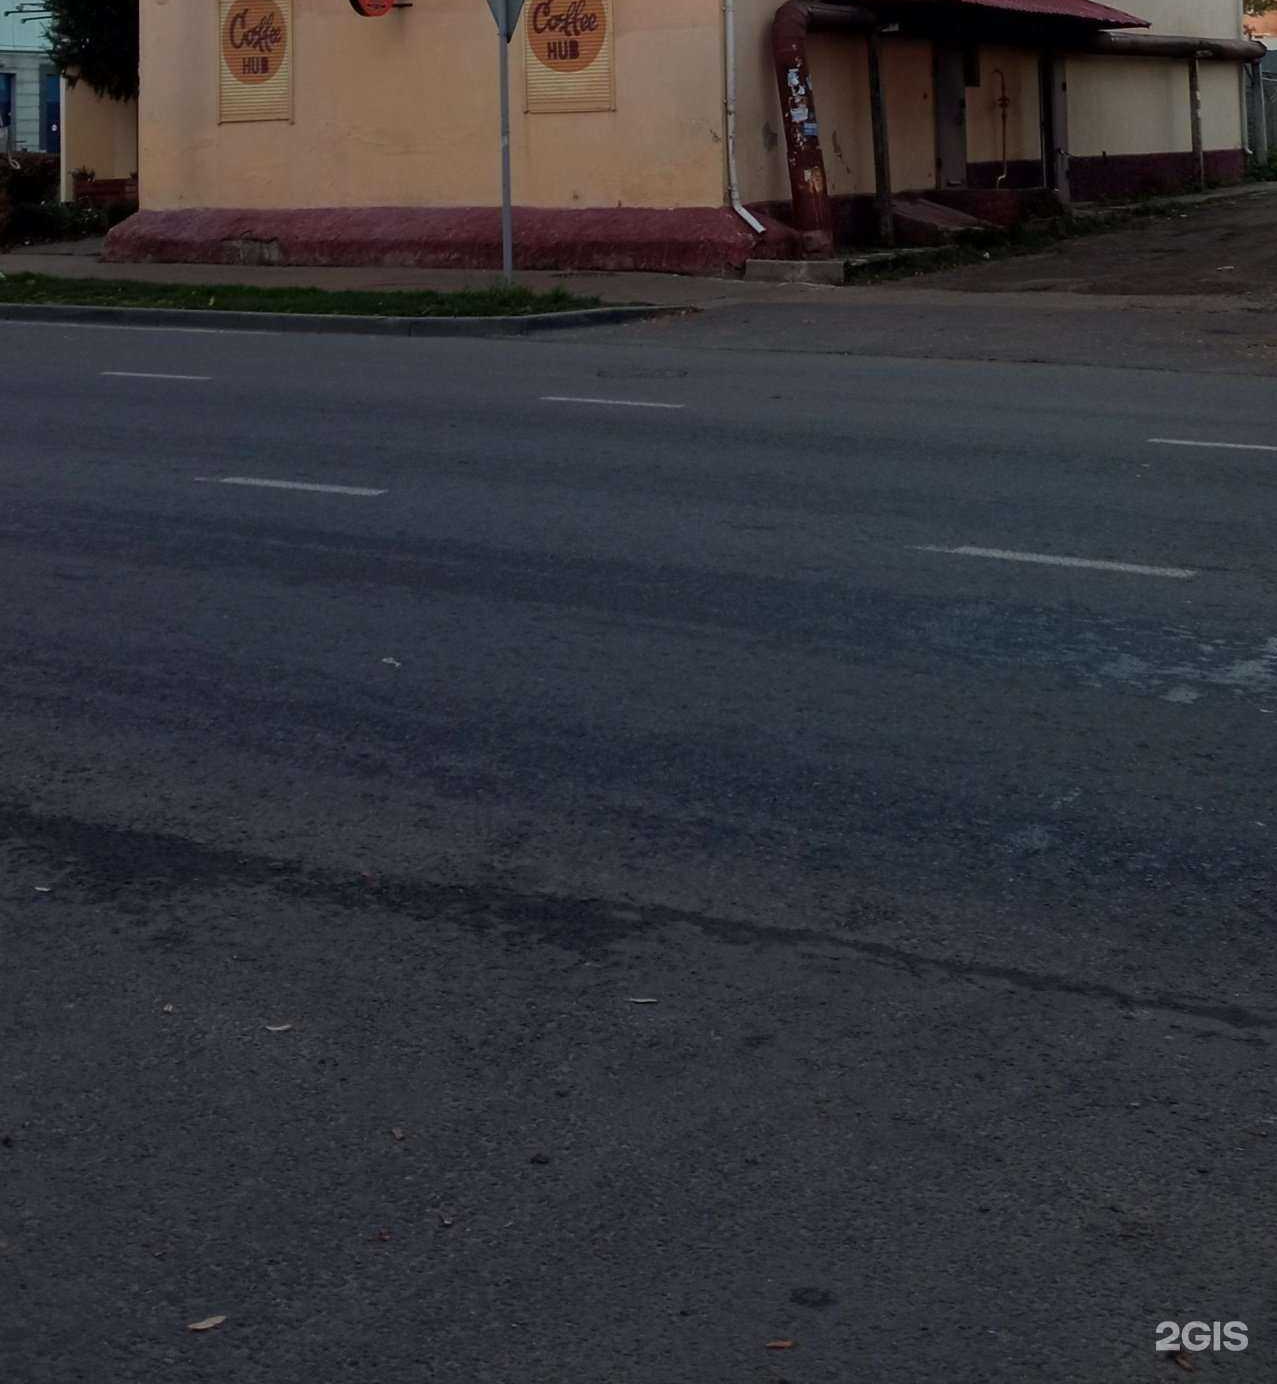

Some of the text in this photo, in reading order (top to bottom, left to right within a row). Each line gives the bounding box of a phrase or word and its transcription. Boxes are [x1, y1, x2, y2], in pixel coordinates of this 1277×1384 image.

[230, 8, 281, 52] Coffee
[547, 40, 580, 60] HUB
[242, 56, 269, 74] HUB
